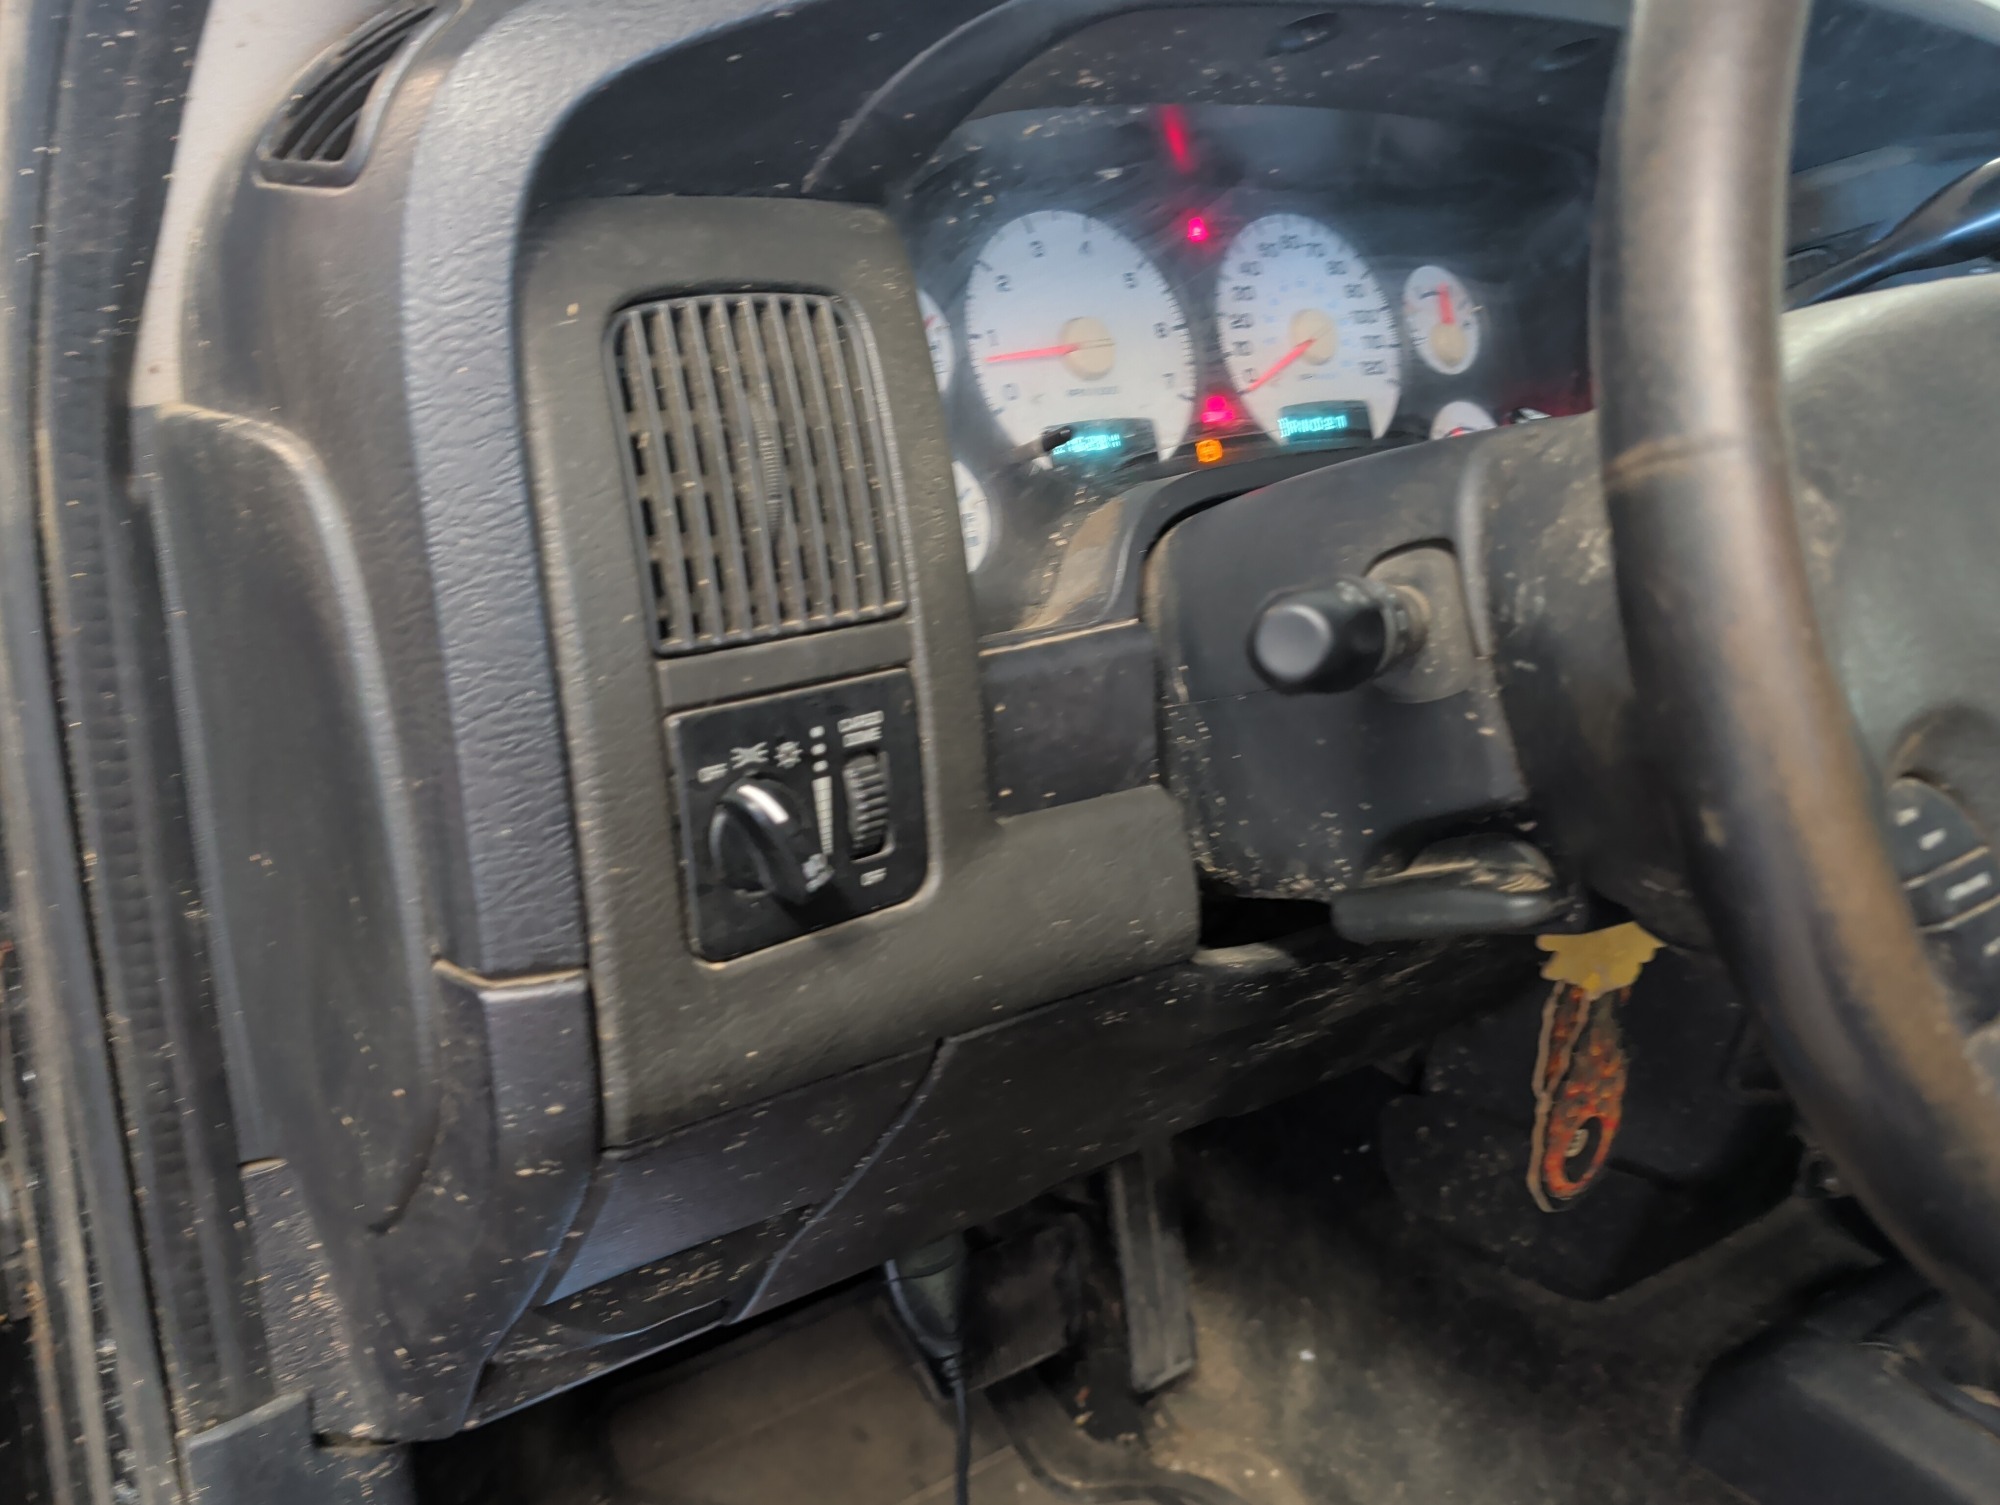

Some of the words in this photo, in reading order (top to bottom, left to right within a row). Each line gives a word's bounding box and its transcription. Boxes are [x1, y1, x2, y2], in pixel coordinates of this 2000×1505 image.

[1239, 260, 1261, 276] 40
[1231, 285, 1255, 301] 30
[1230, 312, 1253, 329] 20
[1350, 308, 1380, 325] 100
[1358, 360, 1387, 376] 120
